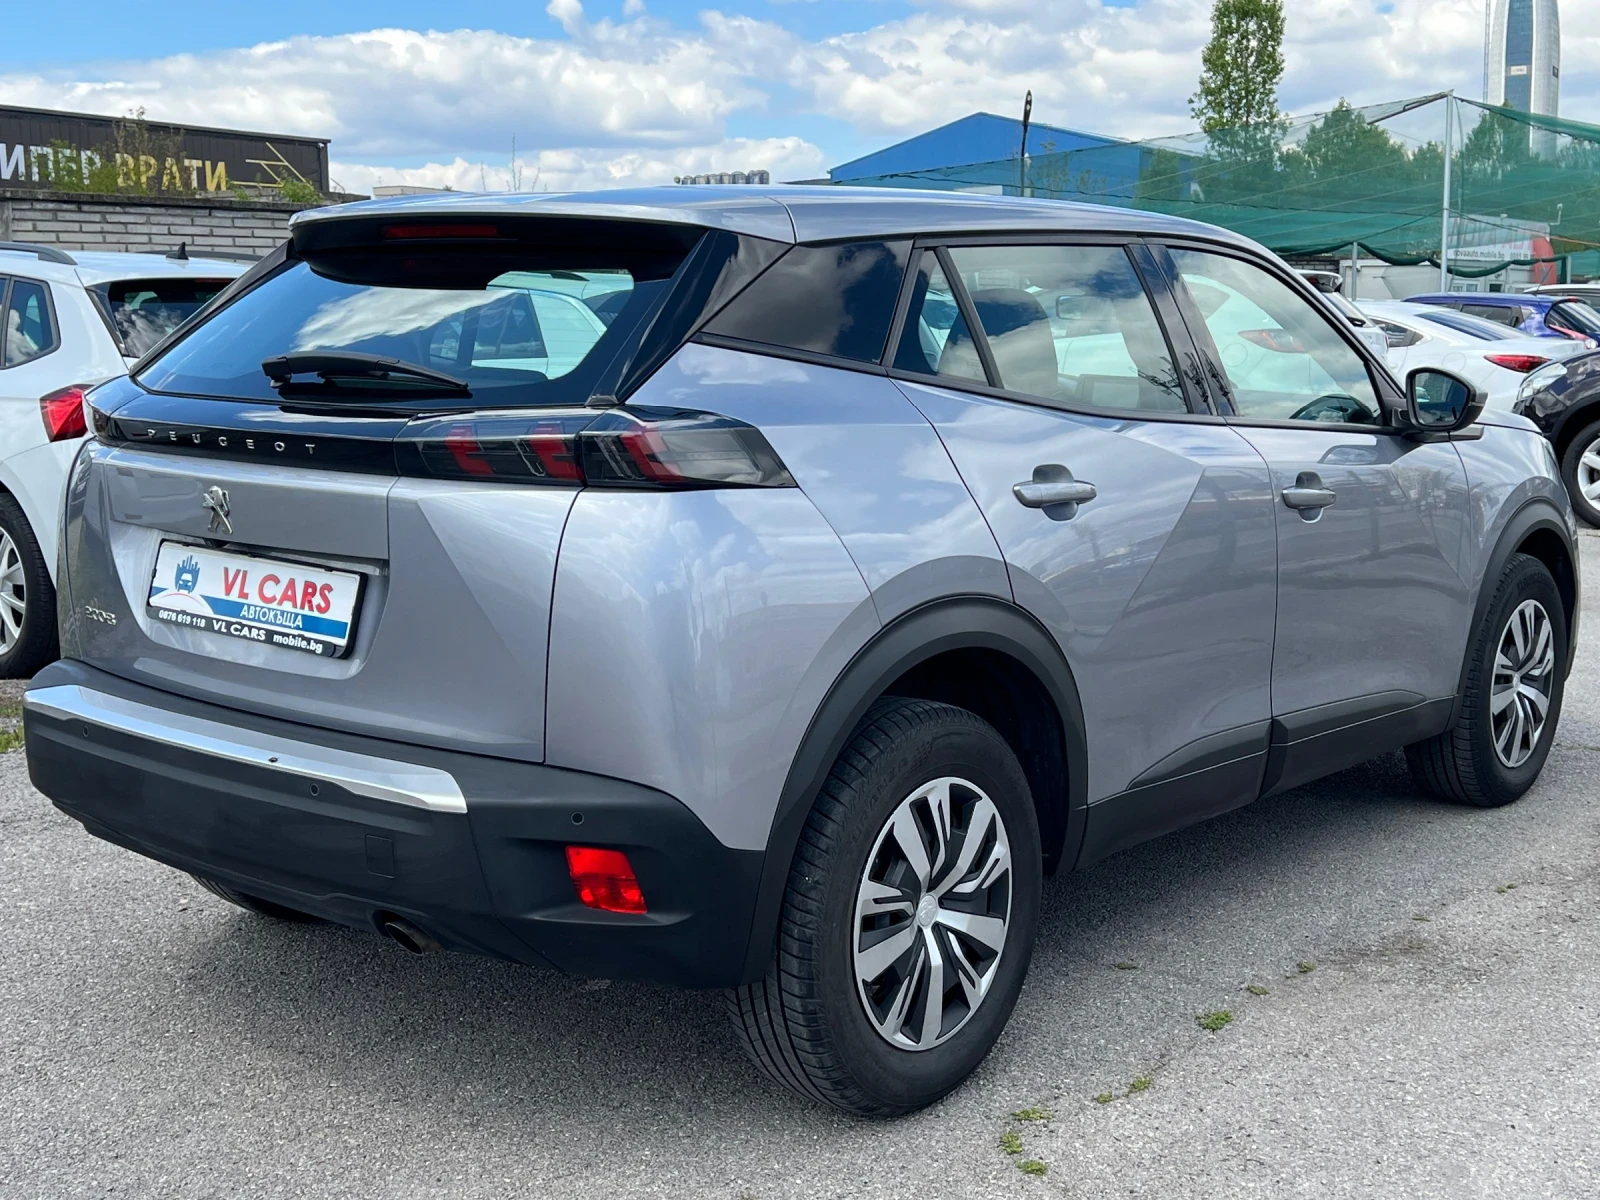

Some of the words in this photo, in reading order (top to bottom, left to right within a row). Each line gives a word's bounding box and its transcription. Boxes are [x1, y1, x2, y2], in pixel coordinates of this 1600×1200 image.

[116, 152, 227, 192] ВРАТИ
[147, 428, 316, 455] PEUGEOT
[223, 566, 250, 600] VL
[257, 573, 334, 614] CARS
[85, 605, 117, 626] 2008
[158, 609, 177, 622] 0876
[177, 613, 191, 626] 619
[191, 616, 206, 628] 118
[211, 619, 228, 633] VL
[229, 624, 266, 641] CARS
[273, 632, 323, 654] mobile.bg
[239, 604, 303, 629] АВТОКЪЩА
